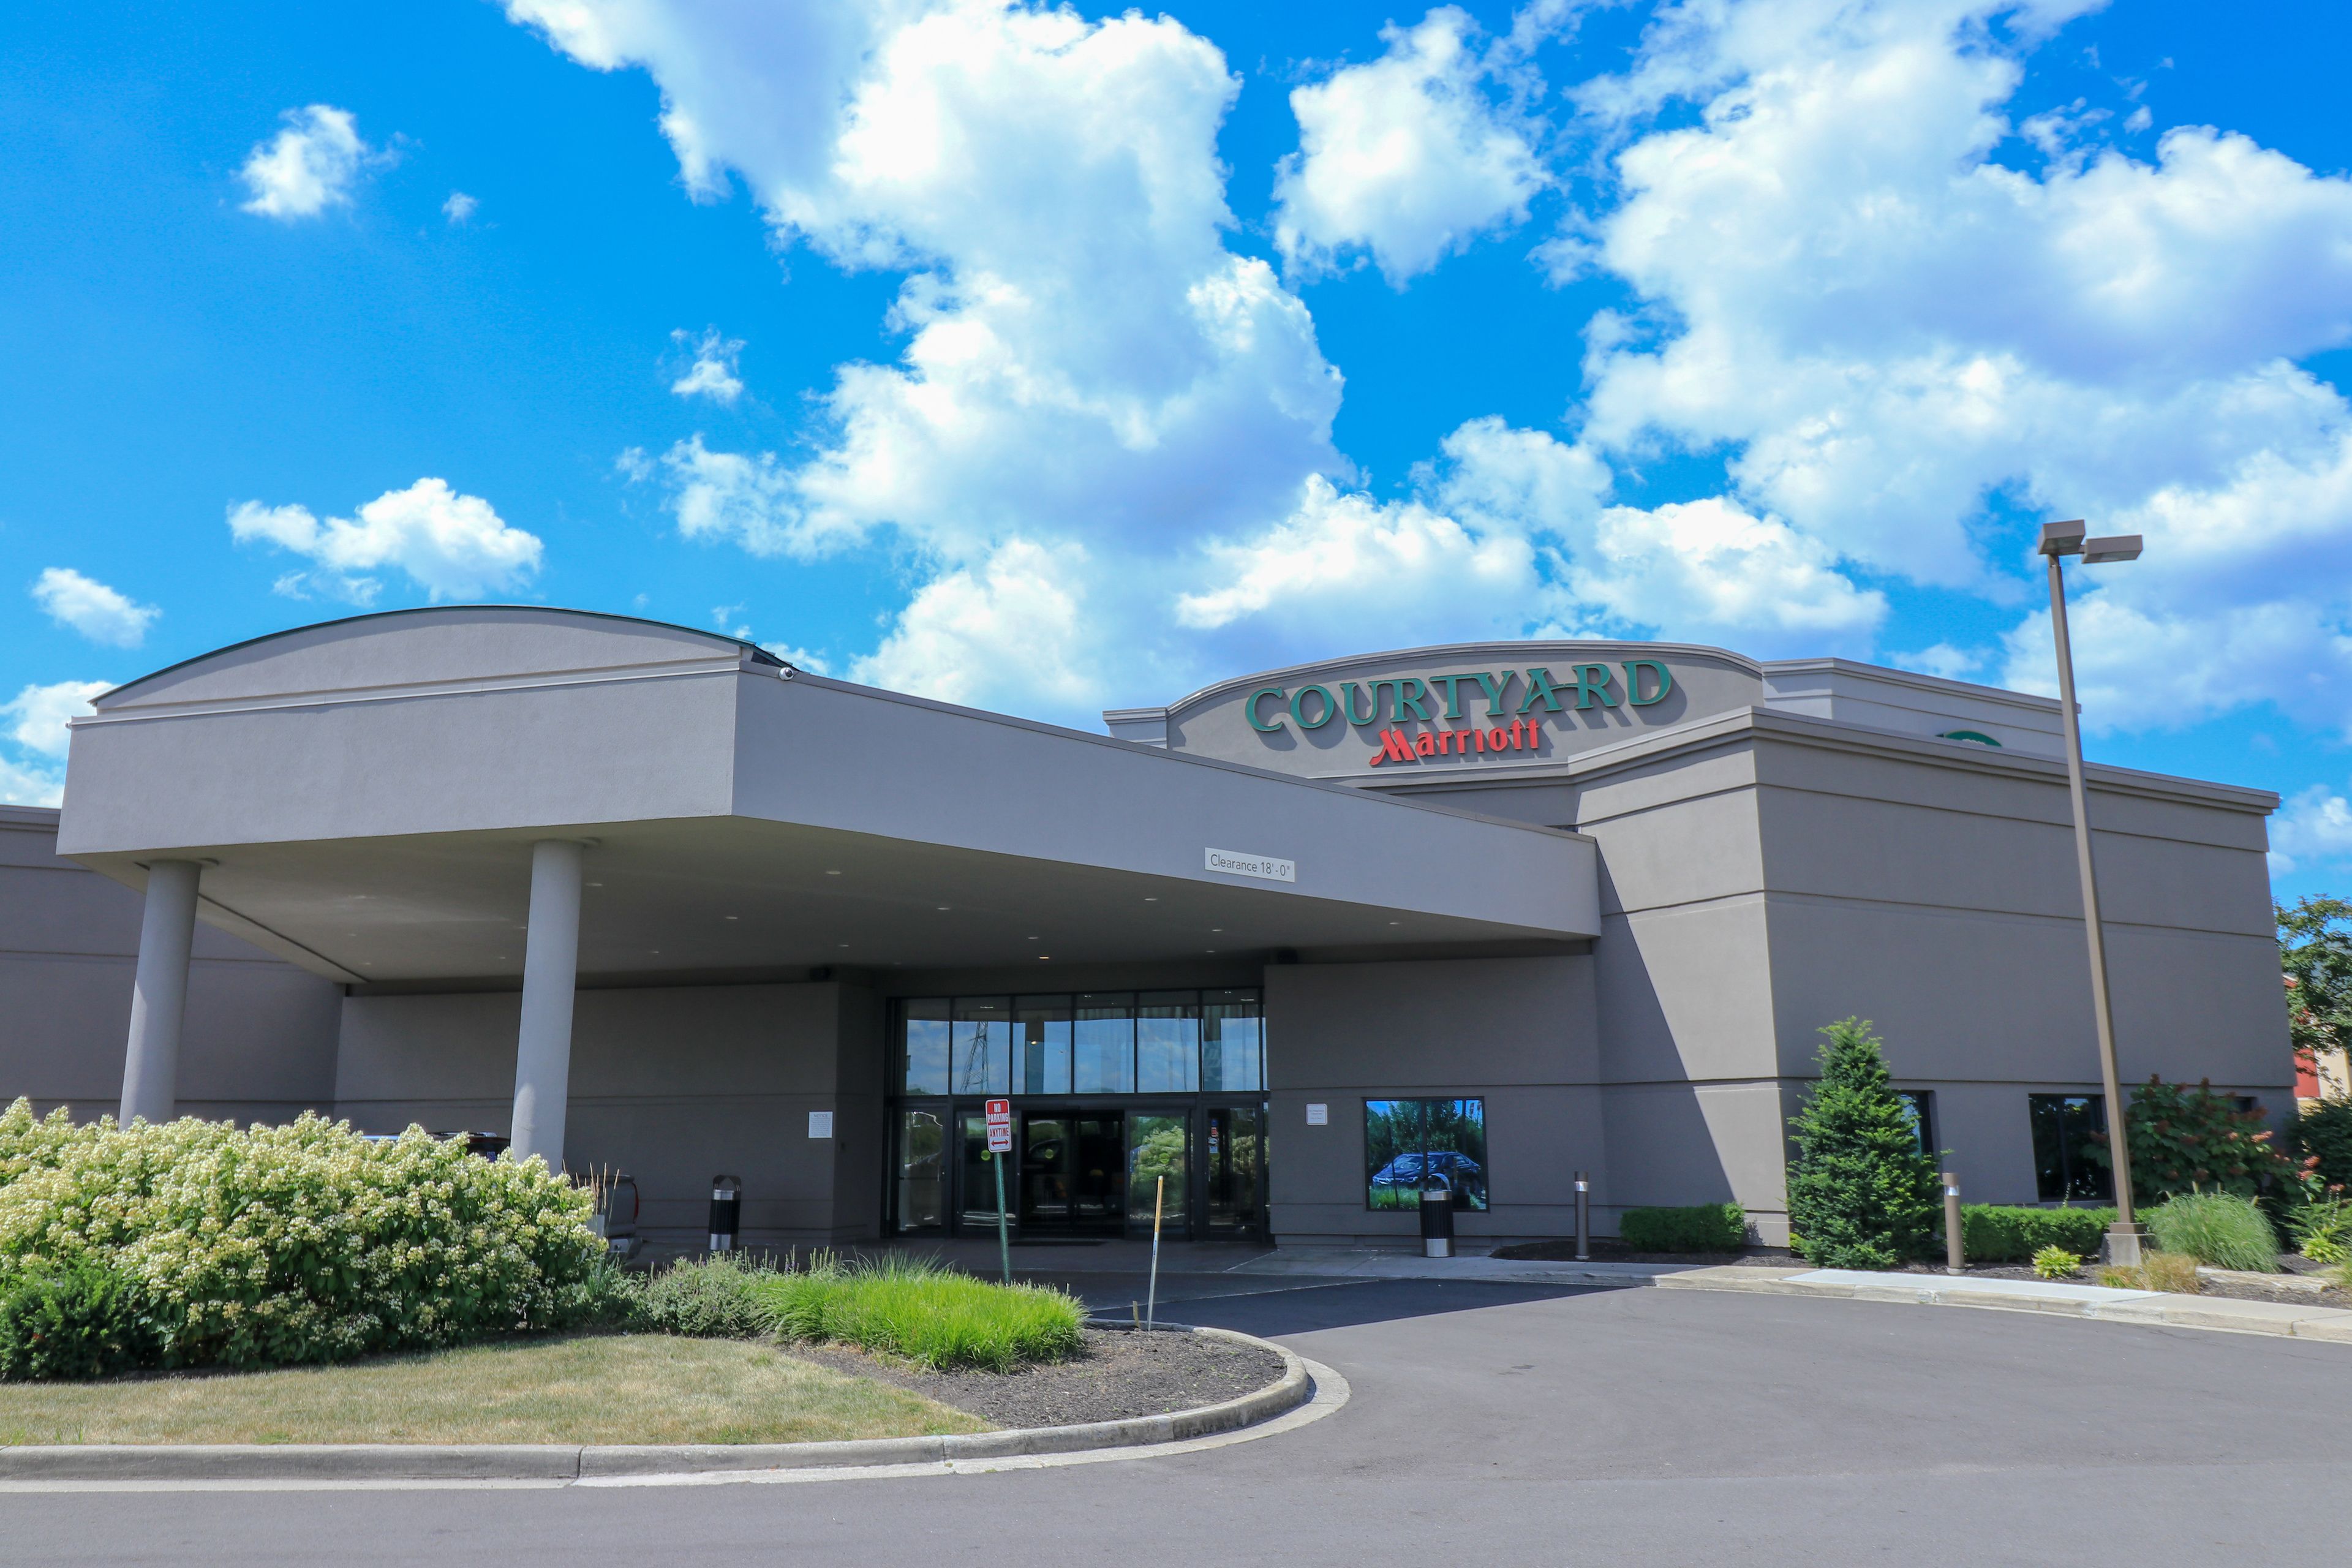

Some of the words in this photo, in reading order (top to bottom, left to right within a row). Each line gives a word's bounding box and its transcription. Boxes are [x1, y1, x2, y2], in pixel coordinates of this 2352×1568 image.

[1245, 660, 1672, 732] COURTYARD
[1369, 718, 1539, 767] Marriott
[1210, 854, 1257, 872] Clearance
[993, 1103, 1001, 1112] NO
[988, 1112, 1008, 1123] PARKING
[990, 1128, 1009, 1137] ANYTIME
